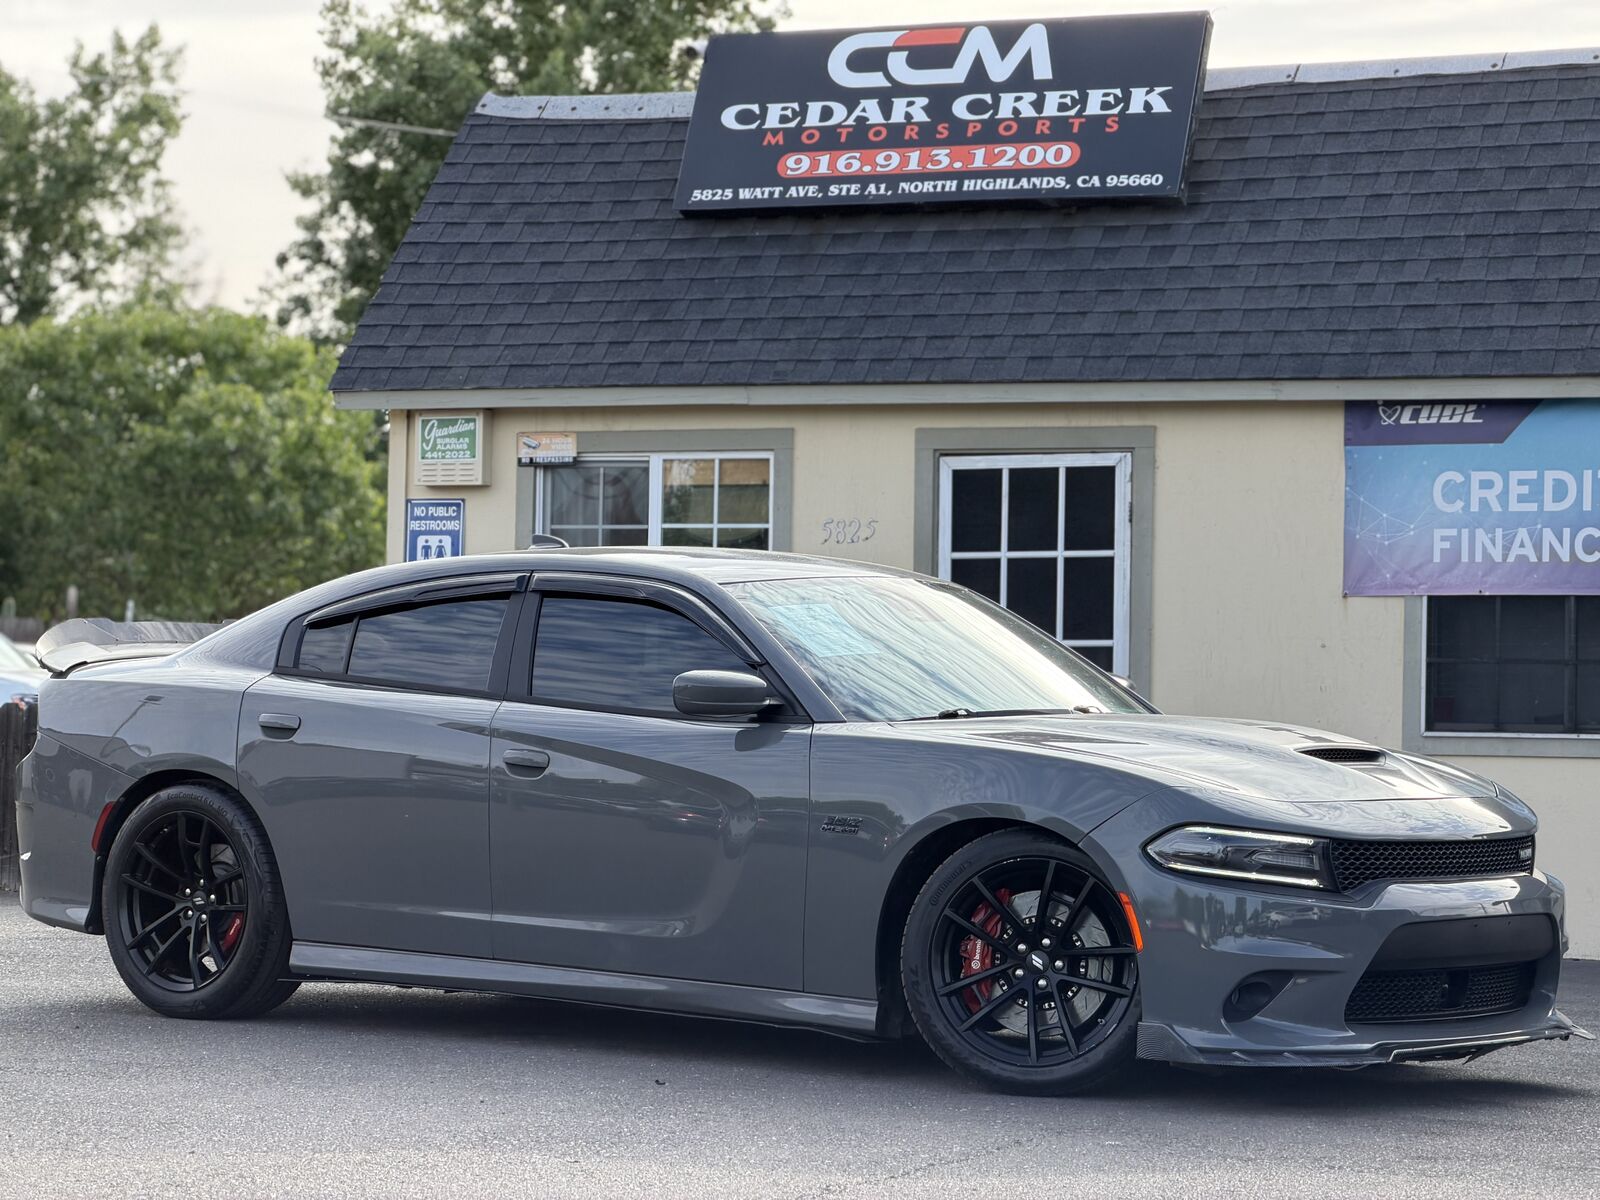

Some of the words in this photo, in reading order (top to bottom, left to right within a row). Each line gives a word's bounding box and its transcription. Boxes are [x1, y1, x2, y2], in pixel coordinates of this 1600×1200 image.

[720, 96, 932, 130] CEDAR
[951, 86, 1173, 120] CREEK
[762, 116, 1120, 146] MOTORSPORTS
[784, 144, 1073, 176] 916.913.1200
[691, 188, 733, 202] 5825
[738, 186, 783, 200] WATT
[786, 185, 823, 198] AVE,
[828, 183, 862, 196] STE
[866, 182, 893, 196] A1,
[897, 179, 957, 194] NORTH
[962, 176, 1071, 191] HIGHLANDS,
[1076, 175, 1101, 188] CA
[1106, 174, 1163, 188] 95660
[1432, 469, 1600, 513] CREDI
[410, 520, 460, 531] RESTROOMS
[414, 506, 426, 517] NO
[428, 506, 457, 517] PUBLIC
[821, 517, 879, 544] 5825
